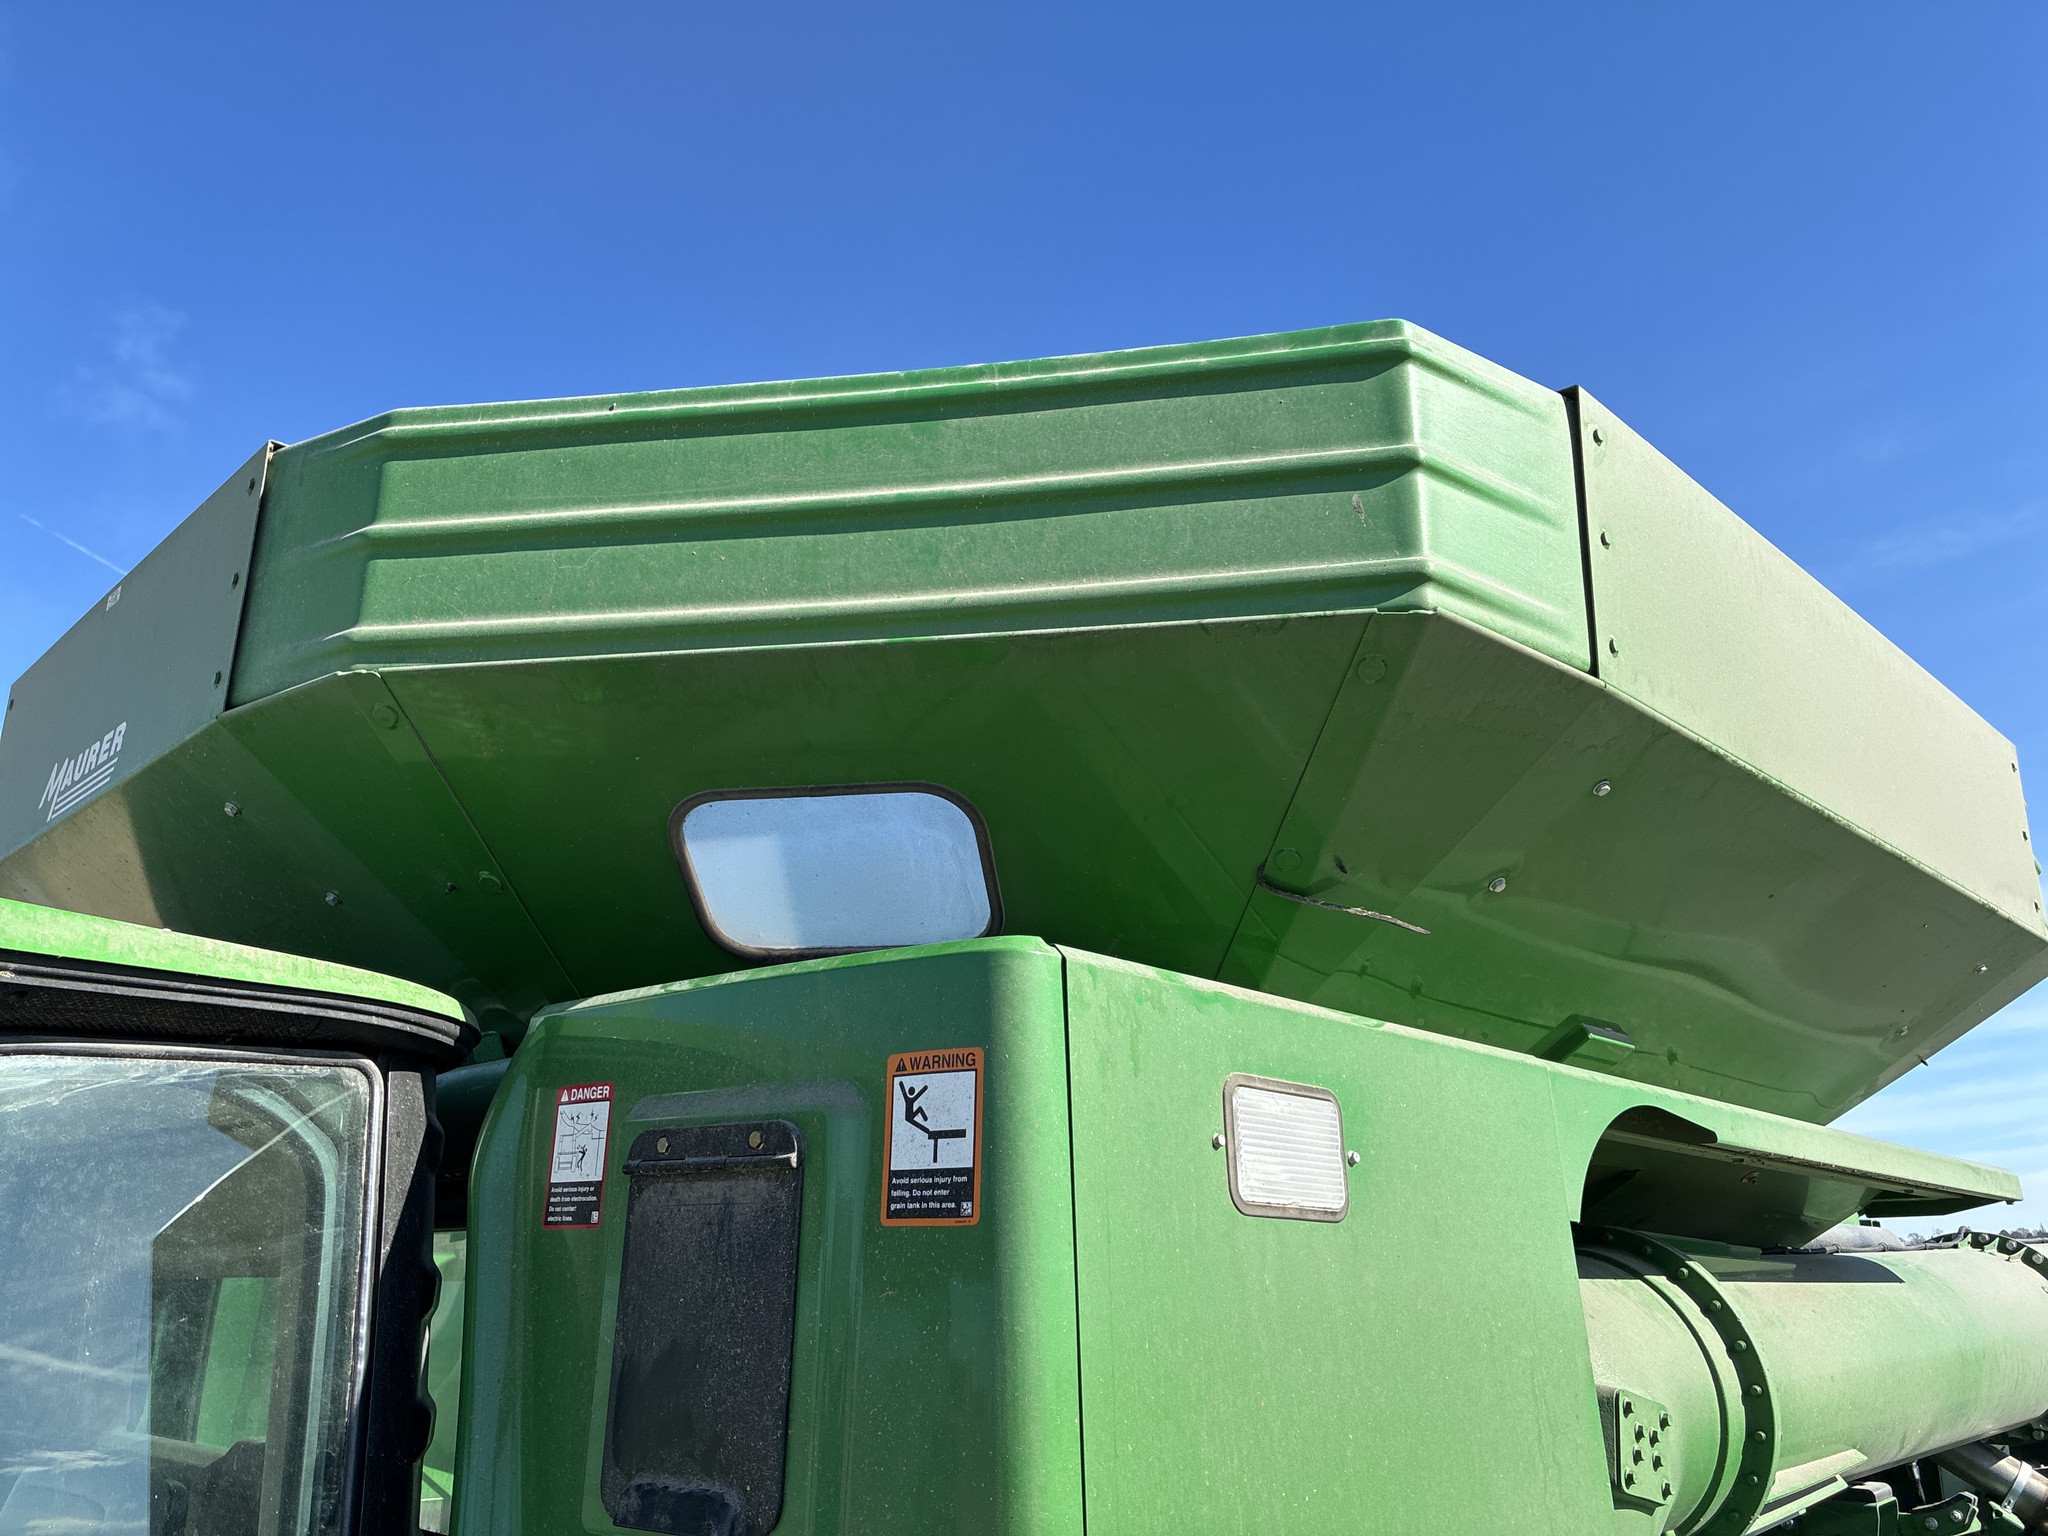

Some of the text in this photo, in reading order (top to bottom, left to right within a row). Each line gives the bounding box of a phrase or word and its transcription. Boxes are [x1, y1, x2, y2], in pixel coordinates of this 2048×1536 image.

[38, 721, 127, 822] MAURER
[909, 1052, 976, 1071] WARNING
[570, 1085, 610, 1101] DANGER
[910, 1176, 932, 1184] serious
[934, 1176, 951, 1184] injury
[891, 1189, 911, 1198] falling.
[890, 1202, 905, 1210] grain
[907, 1201, 920, 1209] tank
